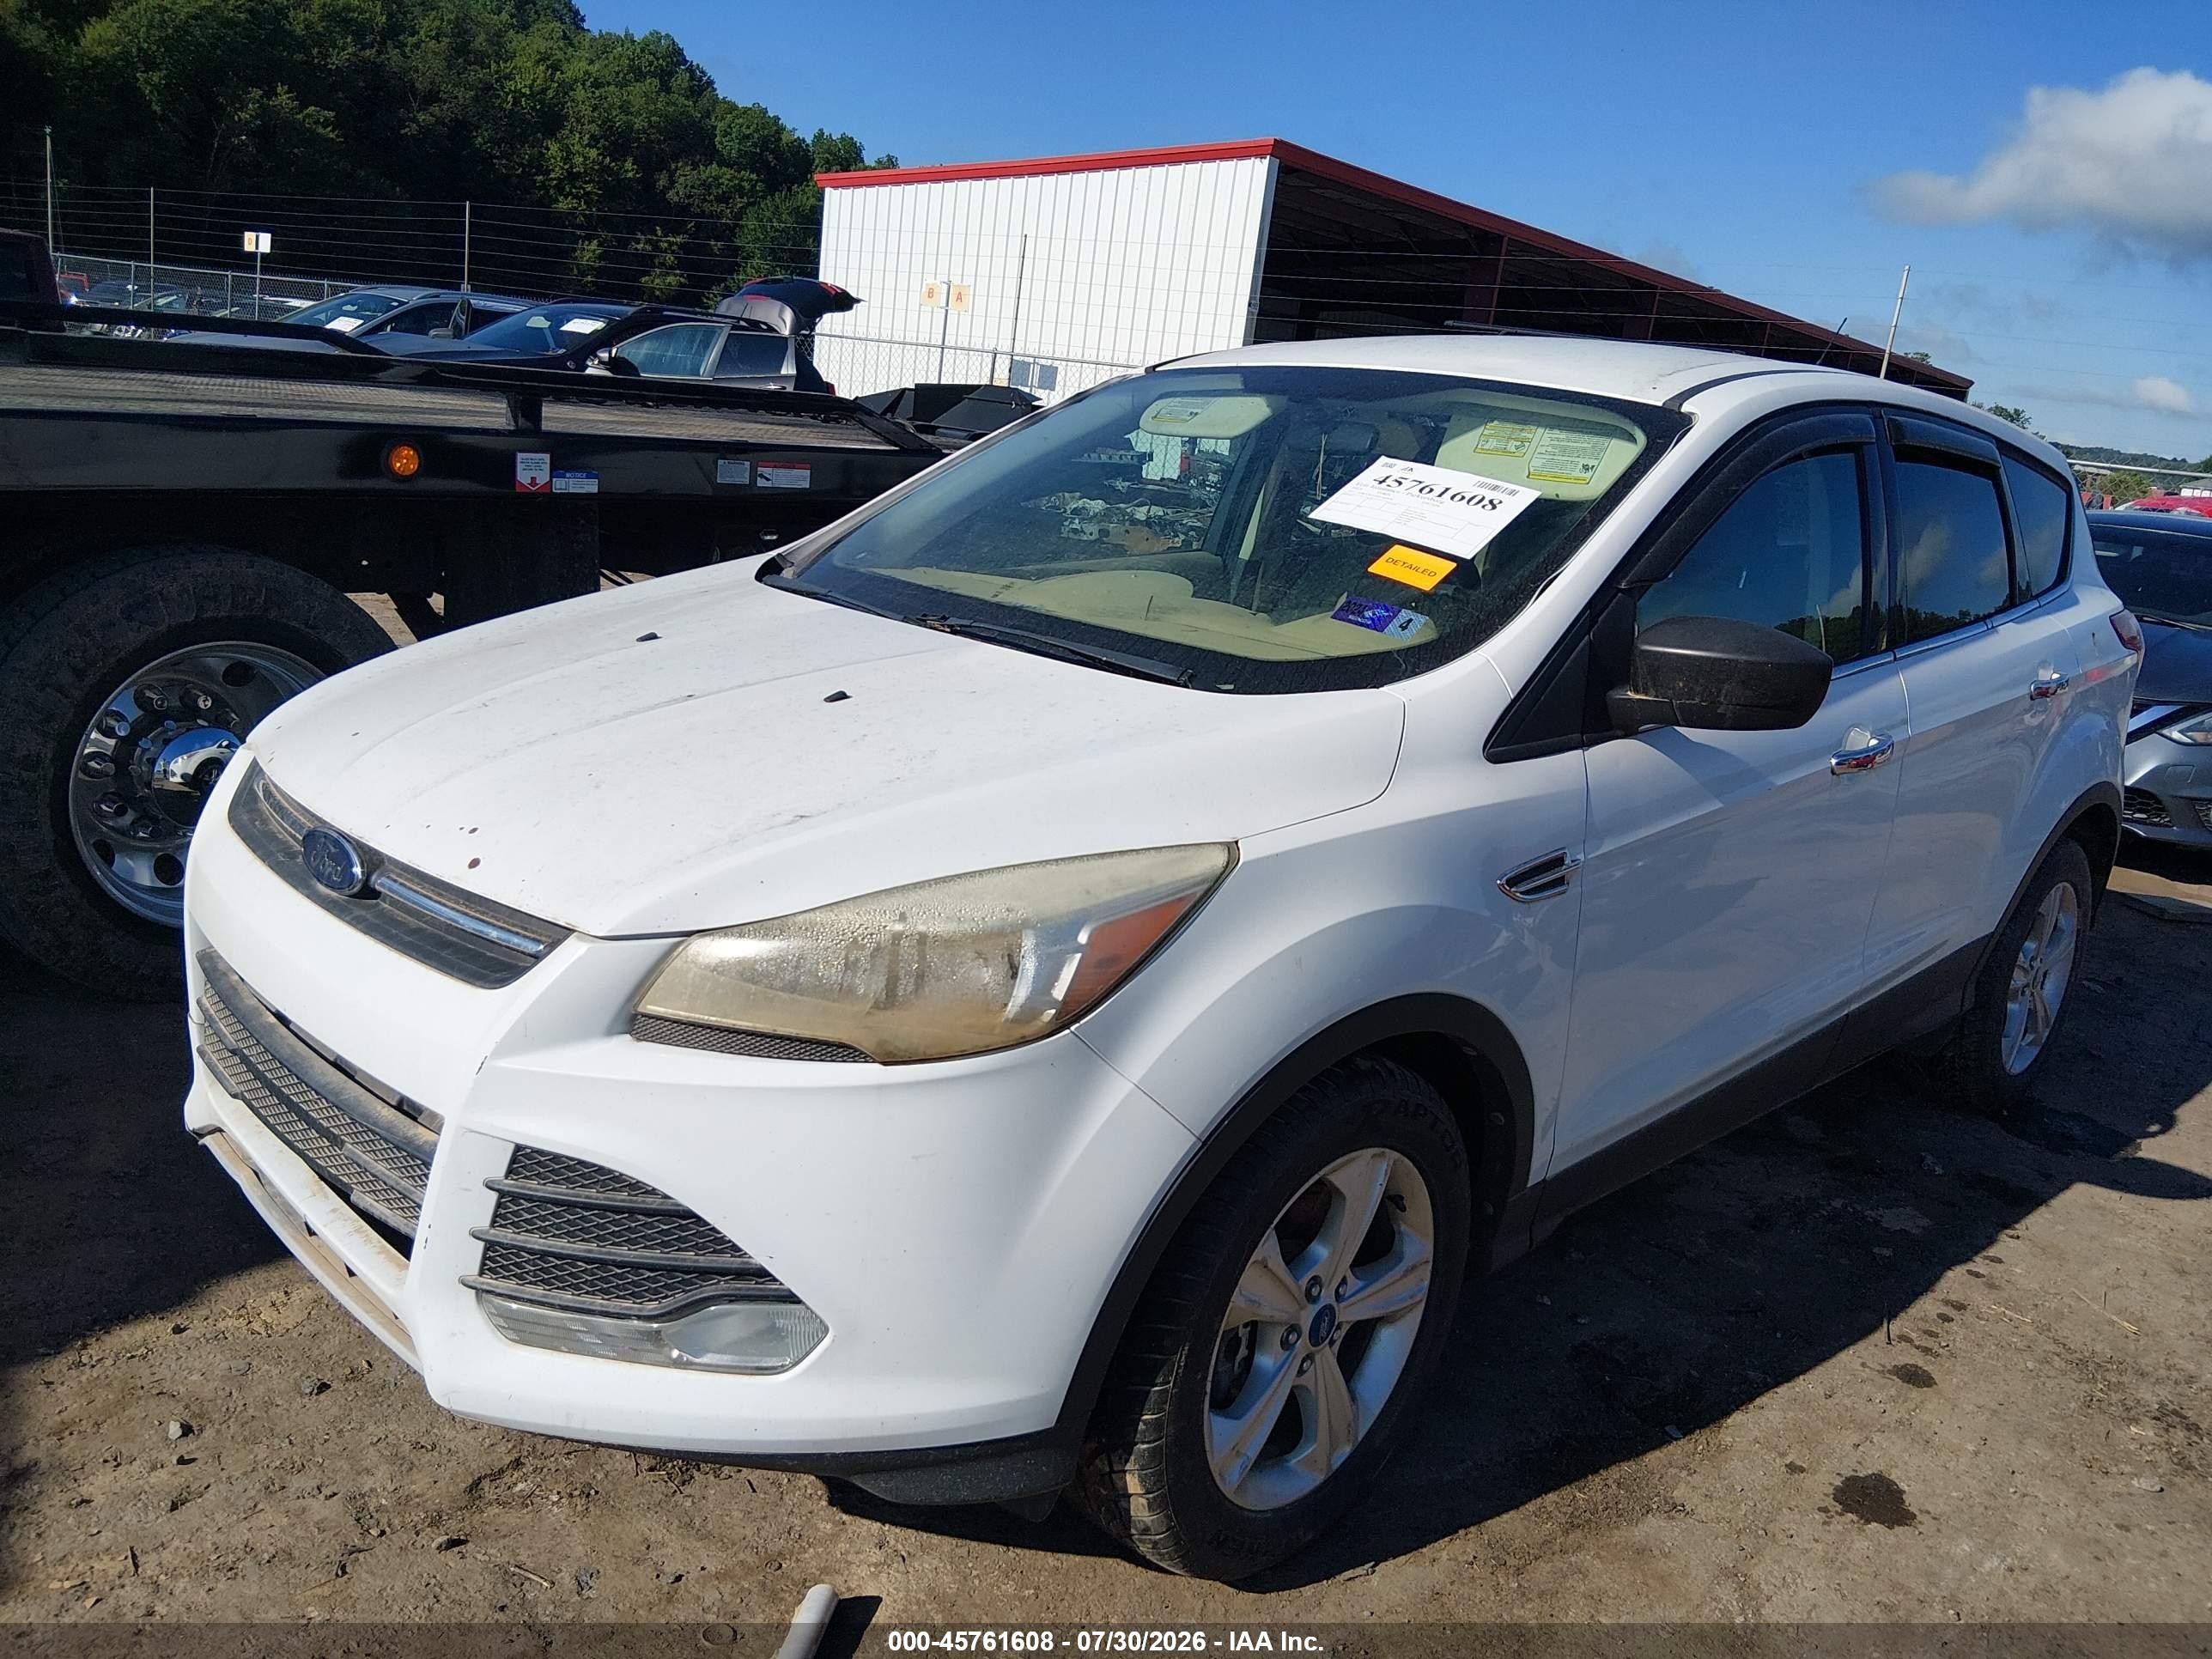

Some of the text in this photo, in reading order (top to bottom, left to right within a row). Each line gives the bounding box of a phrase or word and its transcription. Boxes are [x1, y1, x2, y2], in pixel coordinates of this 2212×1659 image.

[927, 288, 934, 299] B
[955, 291, 963, 303] A
[1372, 474, 1504, 512] 45761608
[1384, 556, 1437, 578] DETAILED
[1398, 617, 1414, 632] 4
[310, 837, 347, 883] Ford
